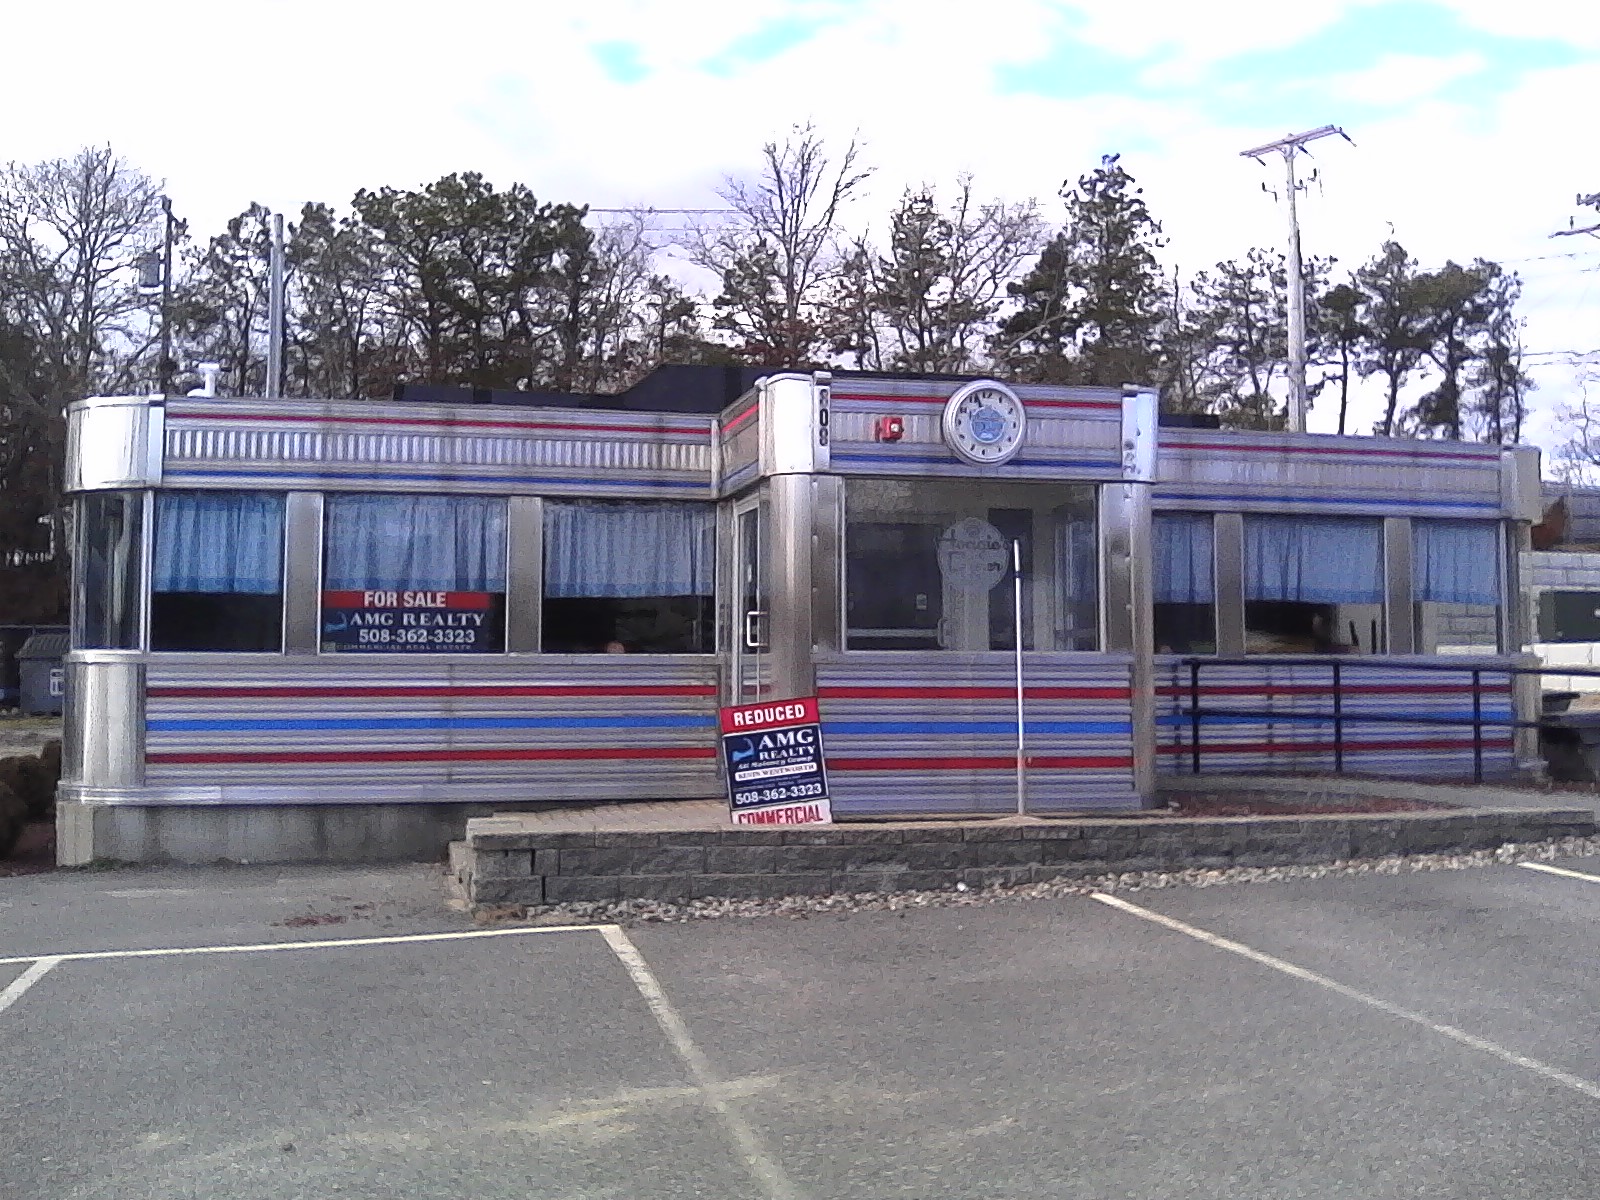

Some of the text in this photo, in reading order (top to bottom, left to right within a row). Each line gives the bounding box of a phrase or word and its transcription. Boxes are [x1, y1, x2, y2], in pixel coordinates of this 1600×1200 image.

[363, 591, 446, 607] FOR SALE
[350, 612, 484, 627] AMG REALTY
[358, 629, 476, 644] 508-362-3323
[734, 704, 804, 726] REDUCED
[759, 729, 814, 749] AMG
[759, 745, 815, 760] REALTY
[735, 783, 822, 804] 508-362-3323
[738, 804, 823, 824] COMMERCIAL
